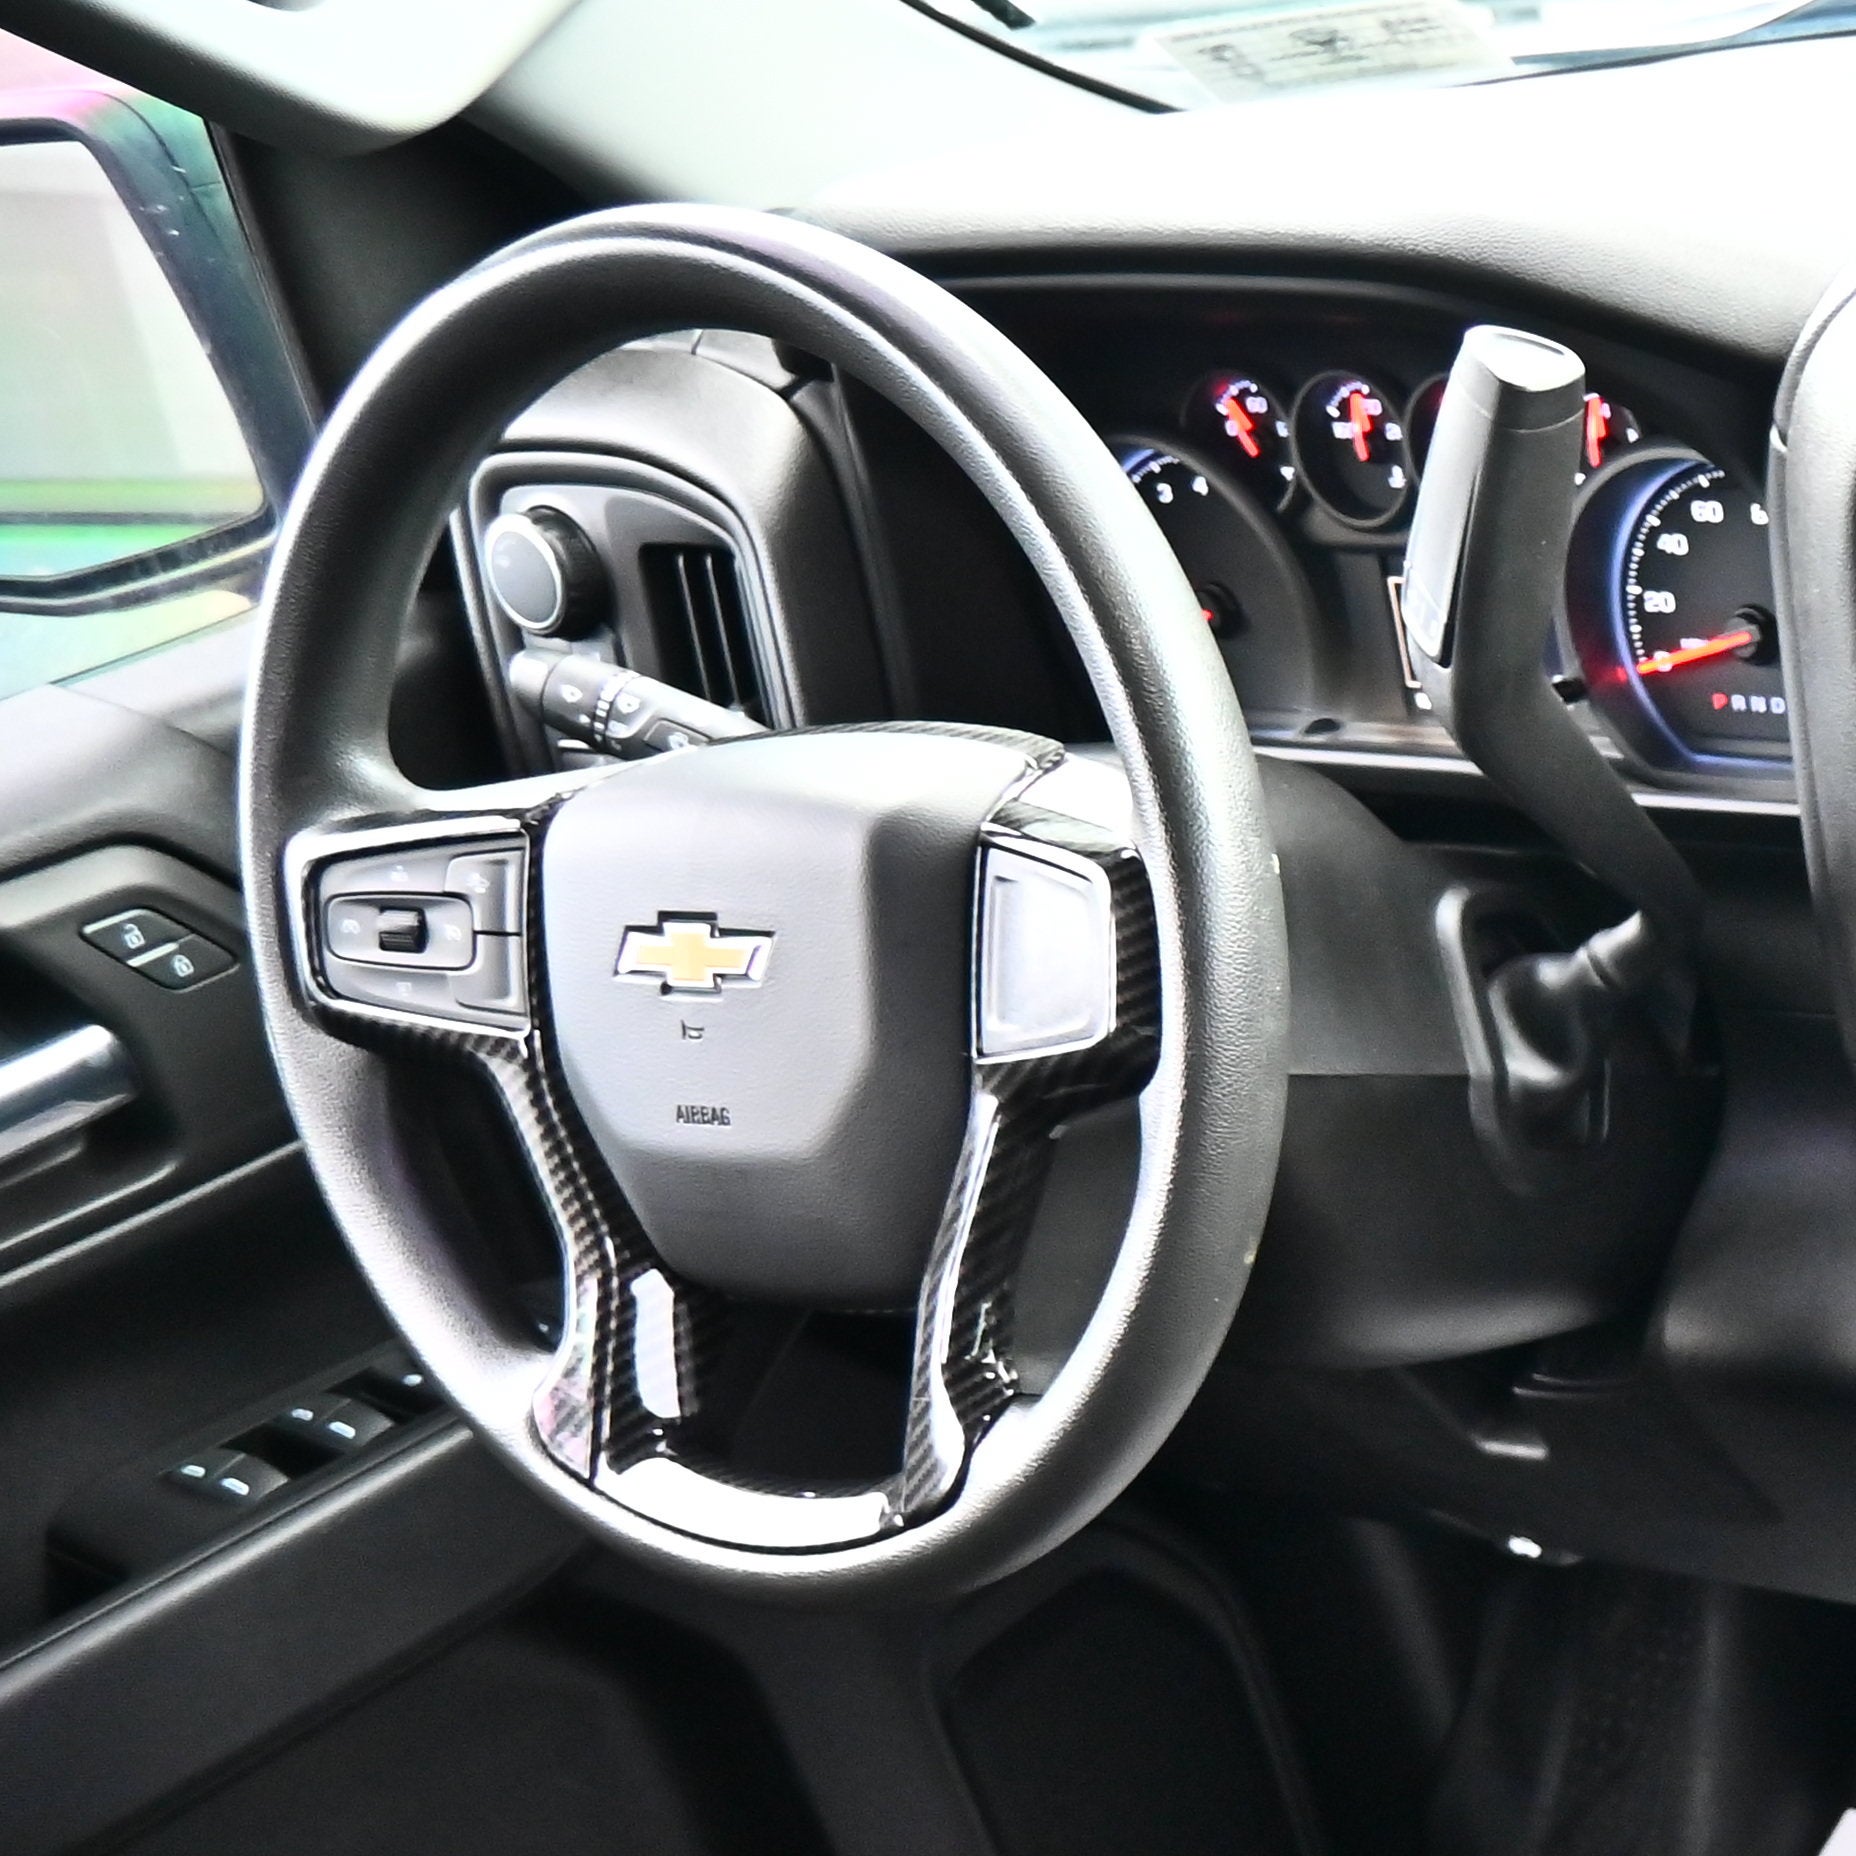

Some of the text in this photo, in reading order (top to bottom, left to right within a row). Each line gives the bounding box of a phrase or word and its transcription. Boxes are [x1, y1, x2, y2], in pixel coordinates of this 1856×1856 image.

[1156, 483, 1174, 504] 3
[1656, 533, 1689, 556] 40
[1643, 591, 1676, 614] 20
[675, 1104, 731, 1127] AIRBAG
